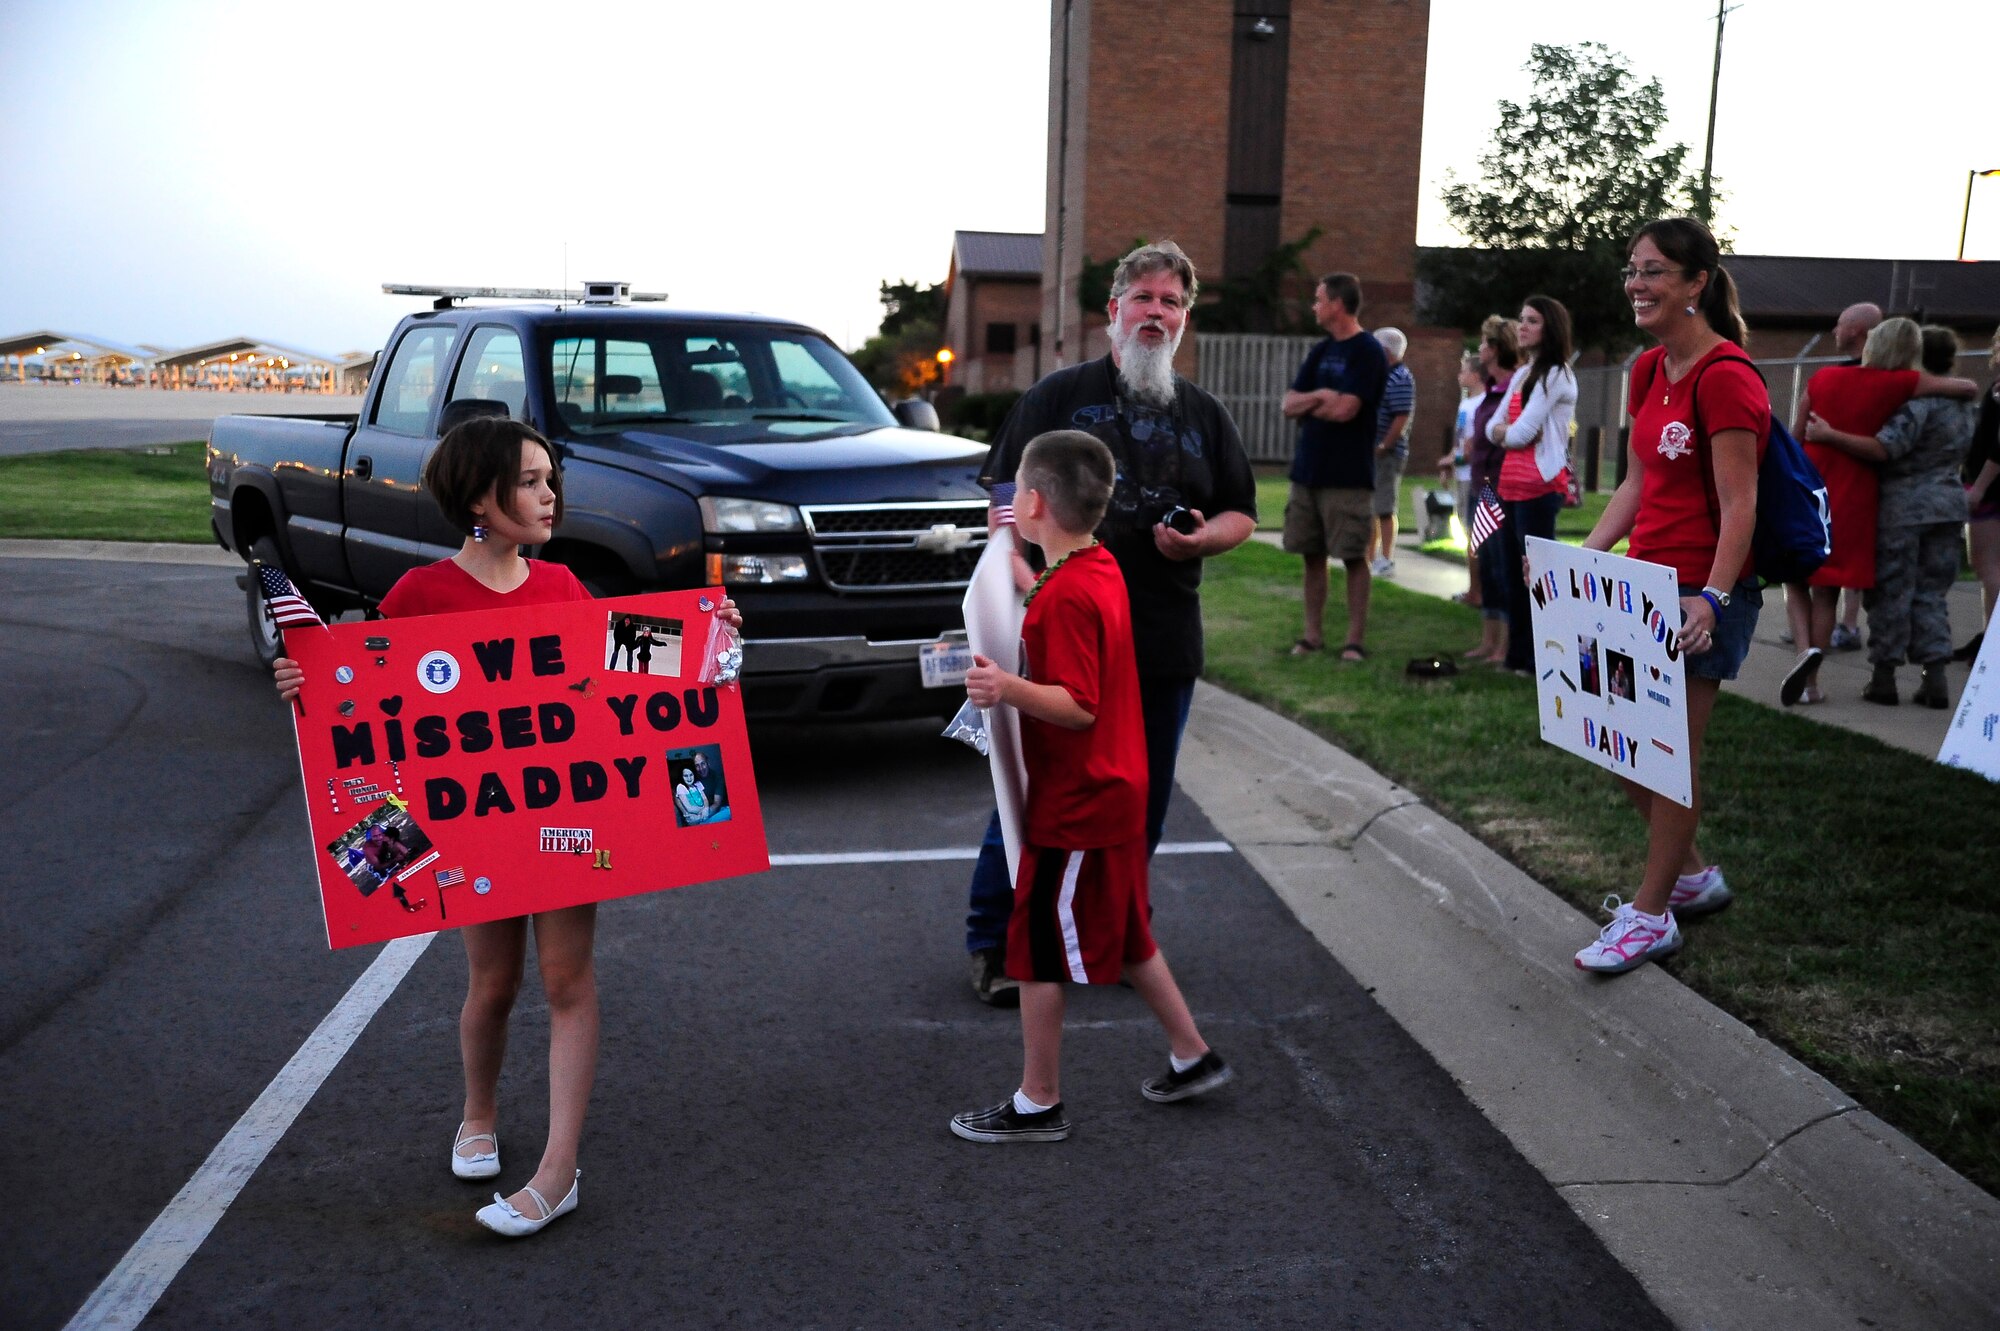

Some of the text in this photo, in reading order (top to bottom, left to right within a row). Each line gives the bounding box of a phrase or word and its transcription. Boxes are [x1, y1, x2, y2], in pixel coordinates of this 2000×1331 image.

[1531, 568, 1681, 662] WE LOVE YOU
[472, 634, 566, 682] WE
[606, 687, 720, 735] YOU
[1583, 717, 1638, 769] DADY
[425, 755, 647, 821] DADDY
[541, 829, 591, 838] AMERICAN
[541, 837, 592, 851] HERO
